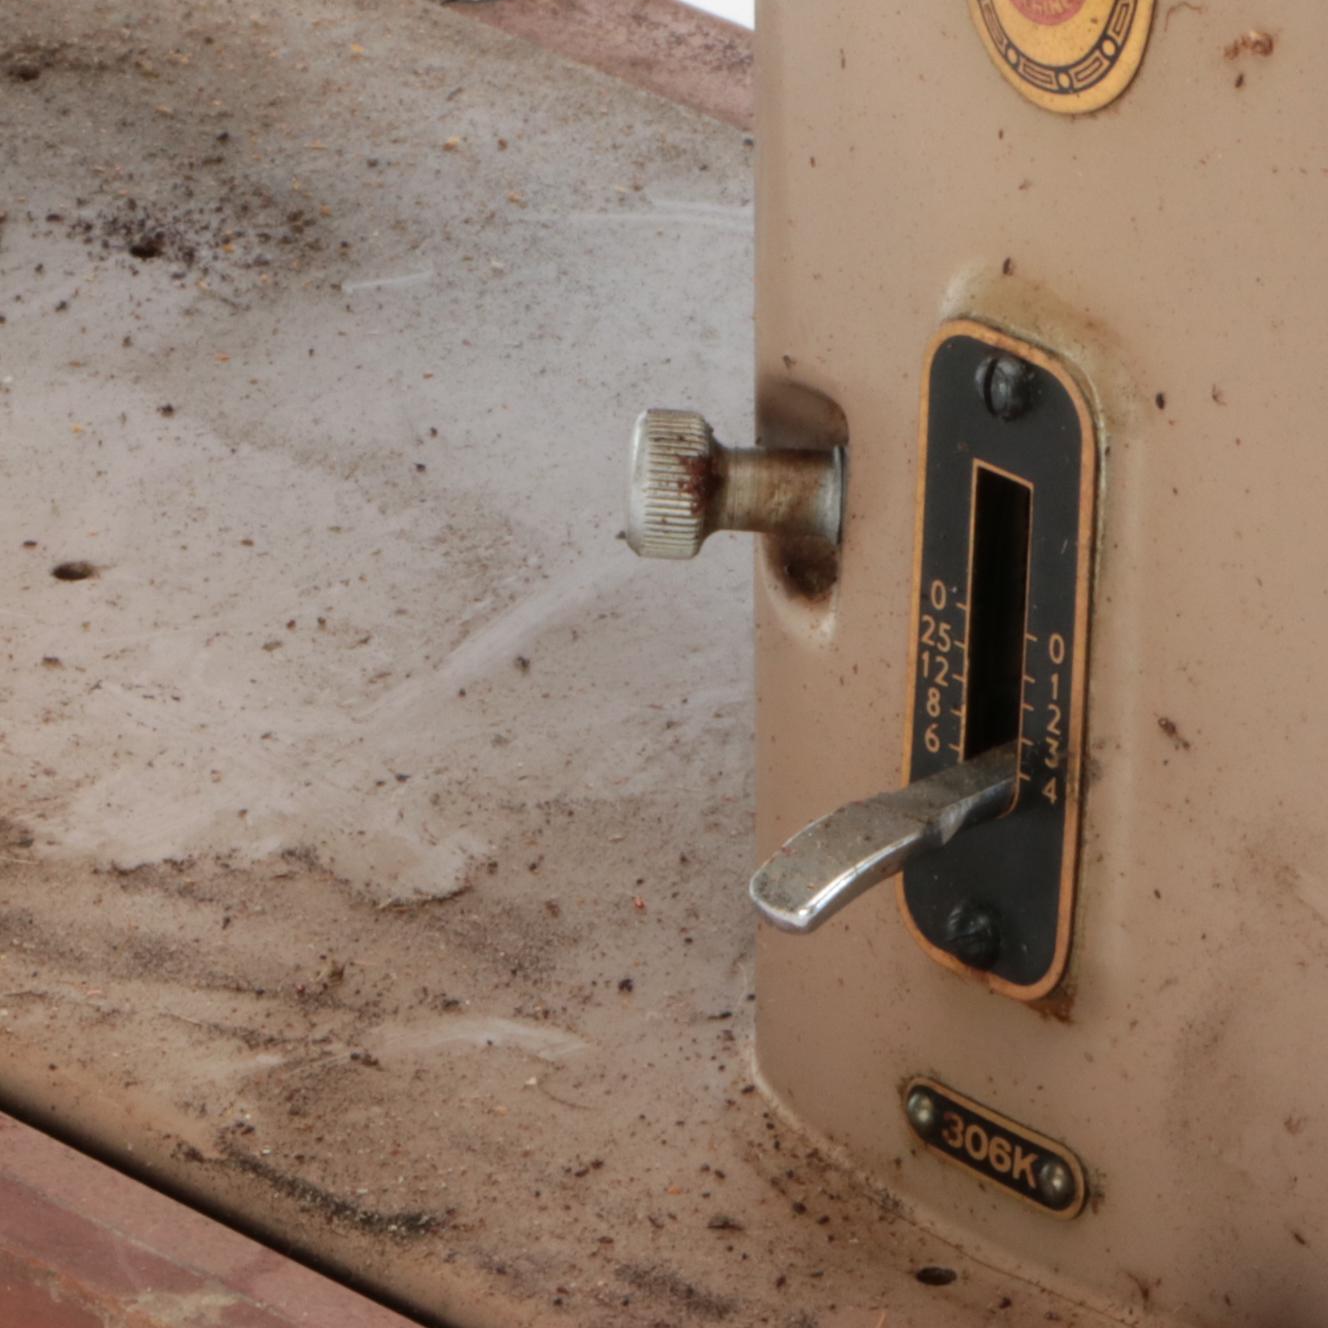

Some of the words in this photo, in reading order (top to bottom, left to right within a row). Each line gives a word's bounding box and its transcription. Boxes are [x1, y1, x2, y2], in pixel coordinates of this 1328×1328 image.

[930, 579, 947, 611] 0
[921, 614, 951, 653] 25
[1049, 632, 1065, 665] 0
[921, 650, 949, 687] 12
[926, 686, 941, 718] 8
[1050, 672, 1060, 701] 1
[1047, 703, 1061, 736] 2
[924, 723, 941, 754] 6
[1043, 736, 1060, 769] 3
[1041, 776, 1058, 806] 4
[941, 1111, 1041, 1190] 306K
